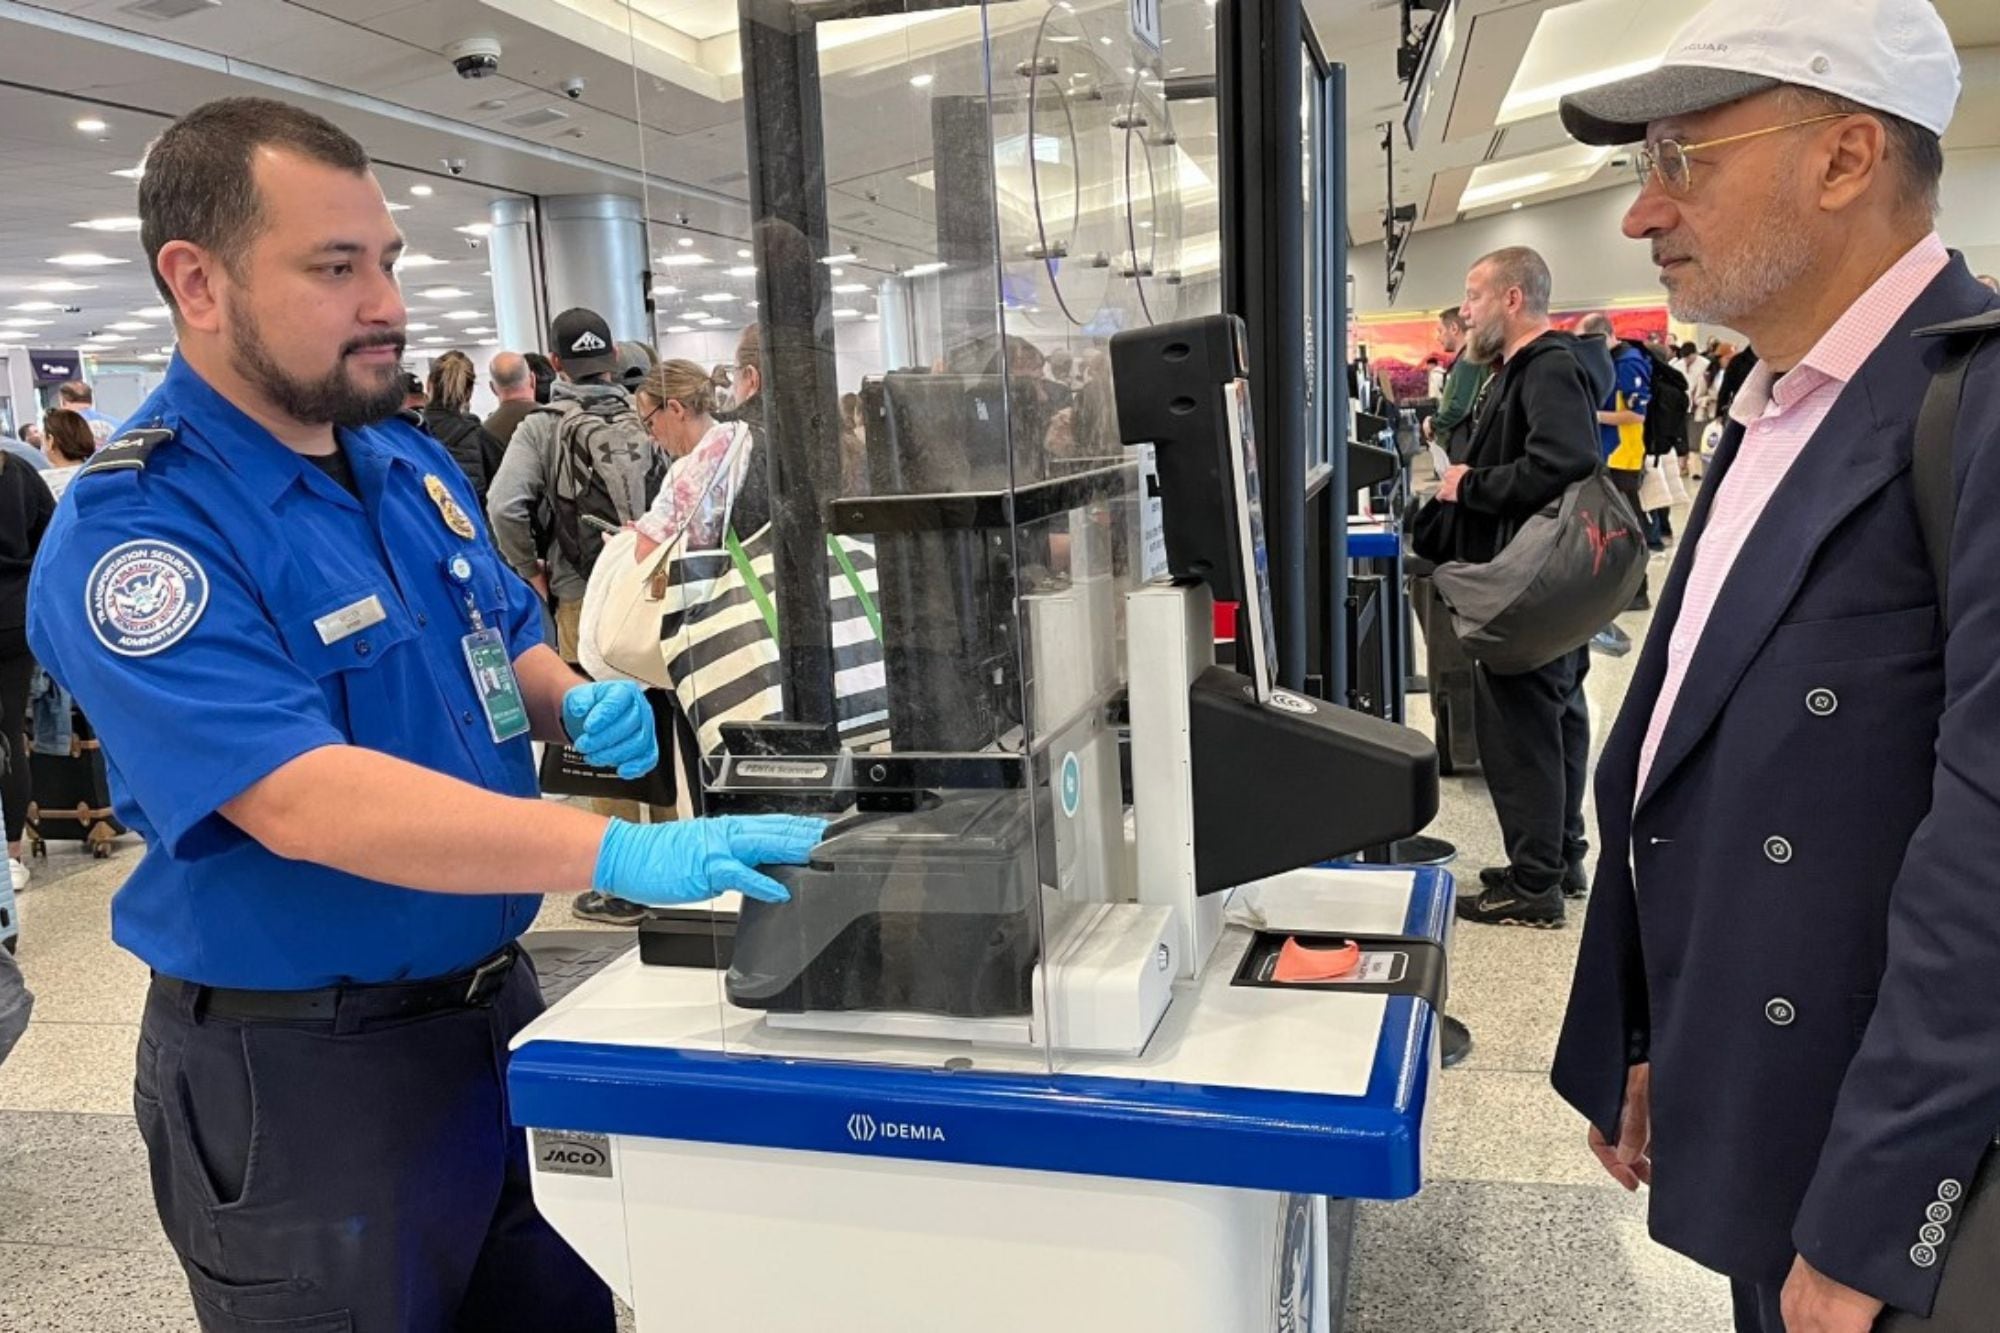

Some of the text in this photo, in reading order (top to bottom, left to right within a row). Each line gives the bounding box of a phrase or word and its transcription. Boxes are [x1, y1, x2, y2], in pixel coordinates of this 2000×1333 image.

[1682, 43, 1728, 52] GUAR
[95, 550, 195, 625] TRANSPORTATION SECURITY
[117, 602, 195, 647] ADMINISTRATION
[880, 1122, 945, 1142] IDEMIA
[543, 1149, 597, 1165] JACO
